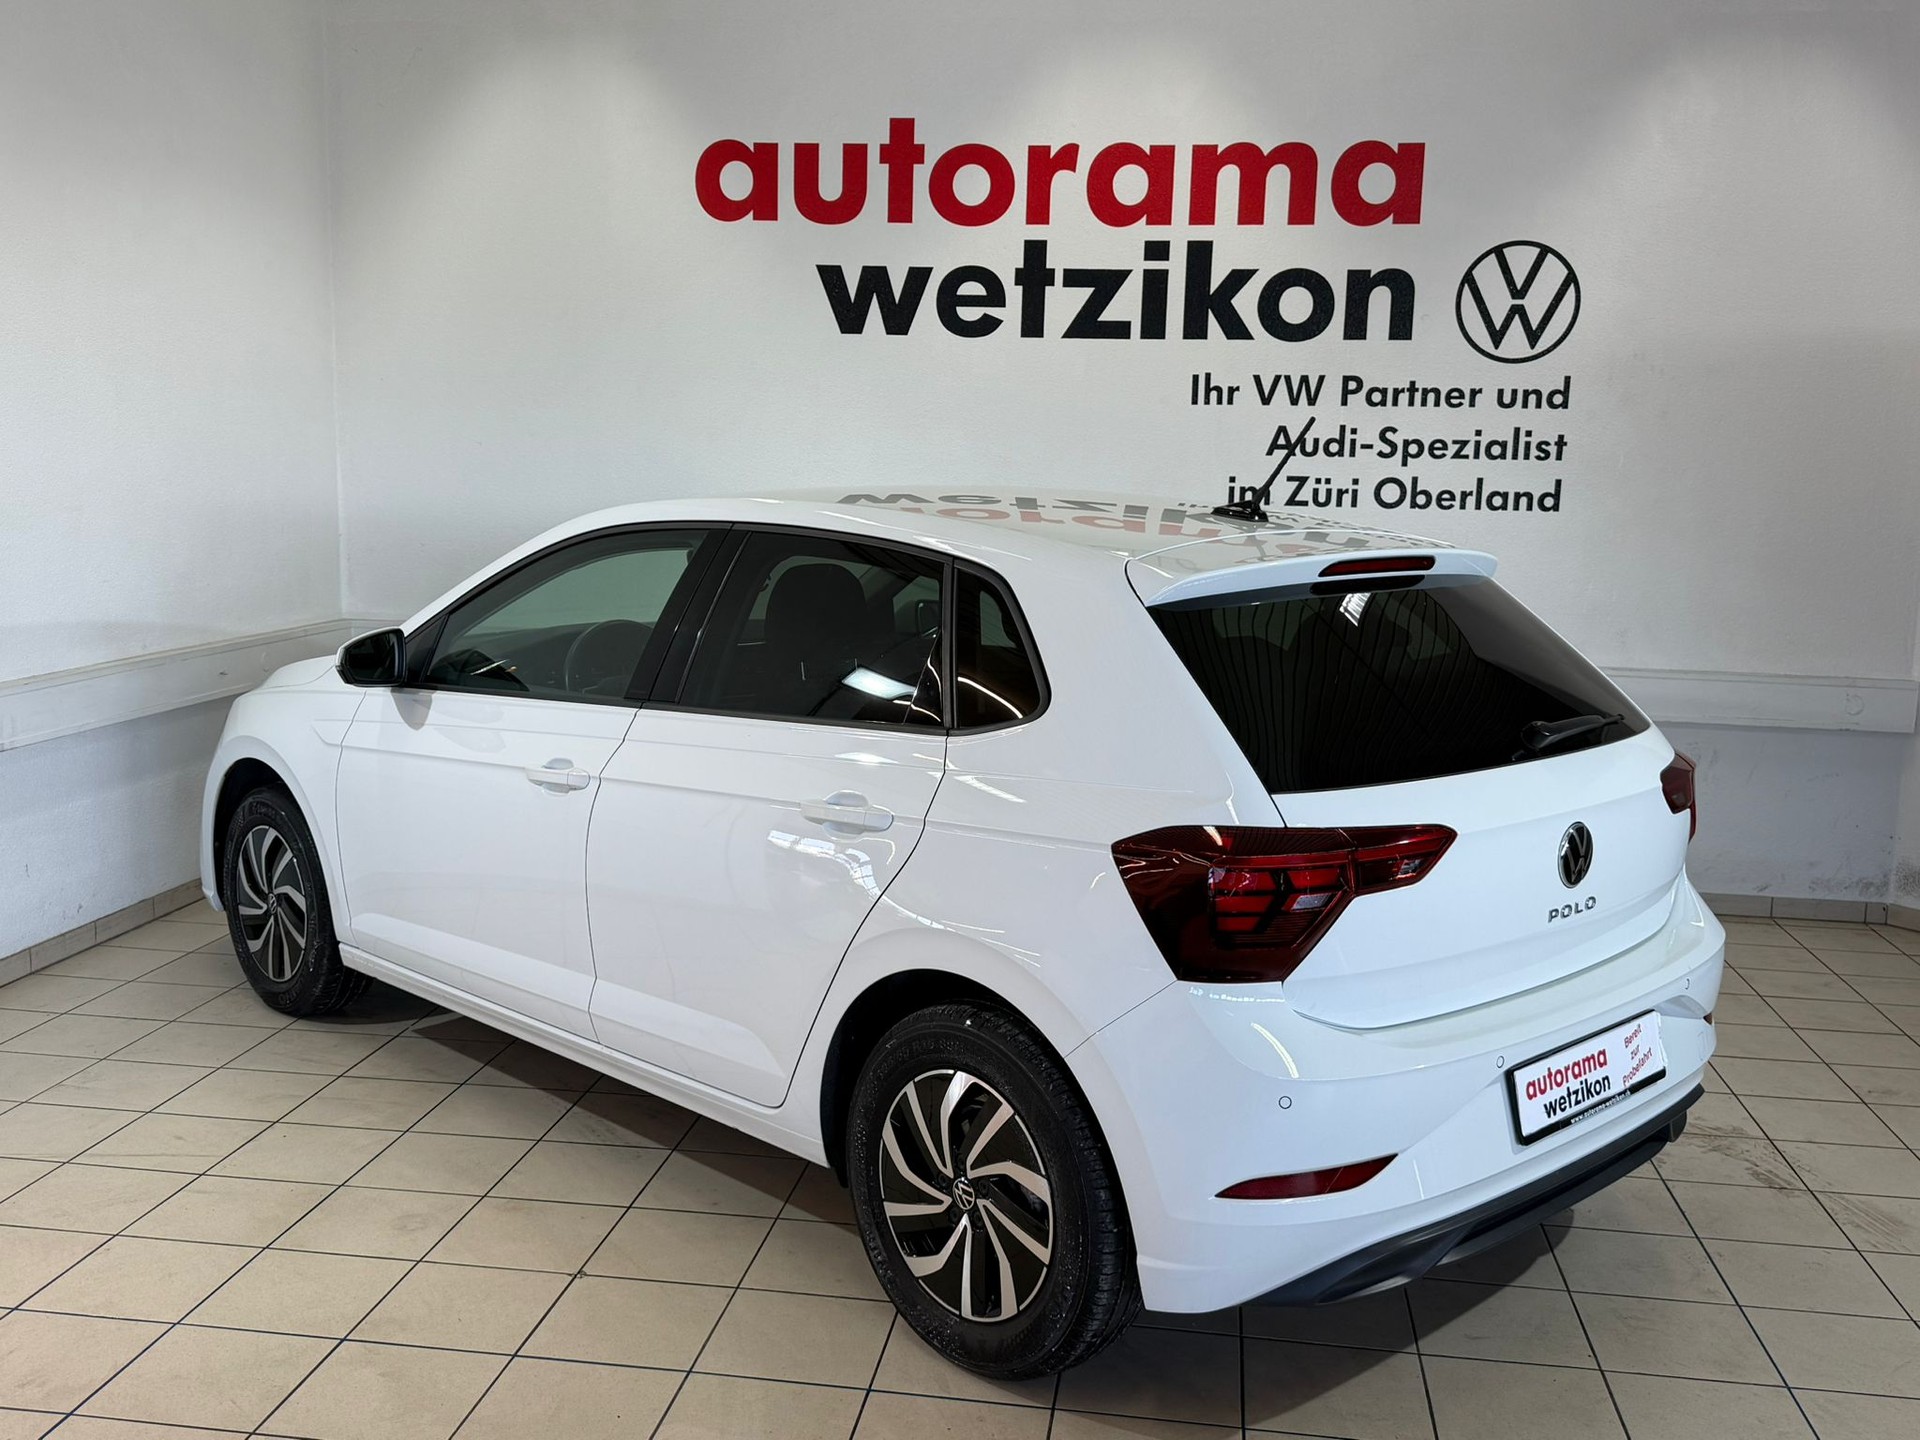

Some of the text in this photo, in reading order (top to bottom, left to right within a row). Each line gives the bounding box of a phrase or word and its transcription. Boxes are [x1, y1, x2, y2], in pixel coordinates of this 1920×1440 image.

[695, 117, 1426, 226] autorama
[815, 240, 1415, 342] wetzikon
[1191, 372, 1572, 410] Ihr VW Partner und
[1265, 424, 1568, 467] Audi-Spezialist
[1283, 475, 1360, 508] Züri
[1373, 476, 1563, 512] Oberland
[1547, 896, 1597, 923] POLO
[1526, 1048, 1608, 1101] autorama
[1543, 1074, 1611, 1119] wetzikon
